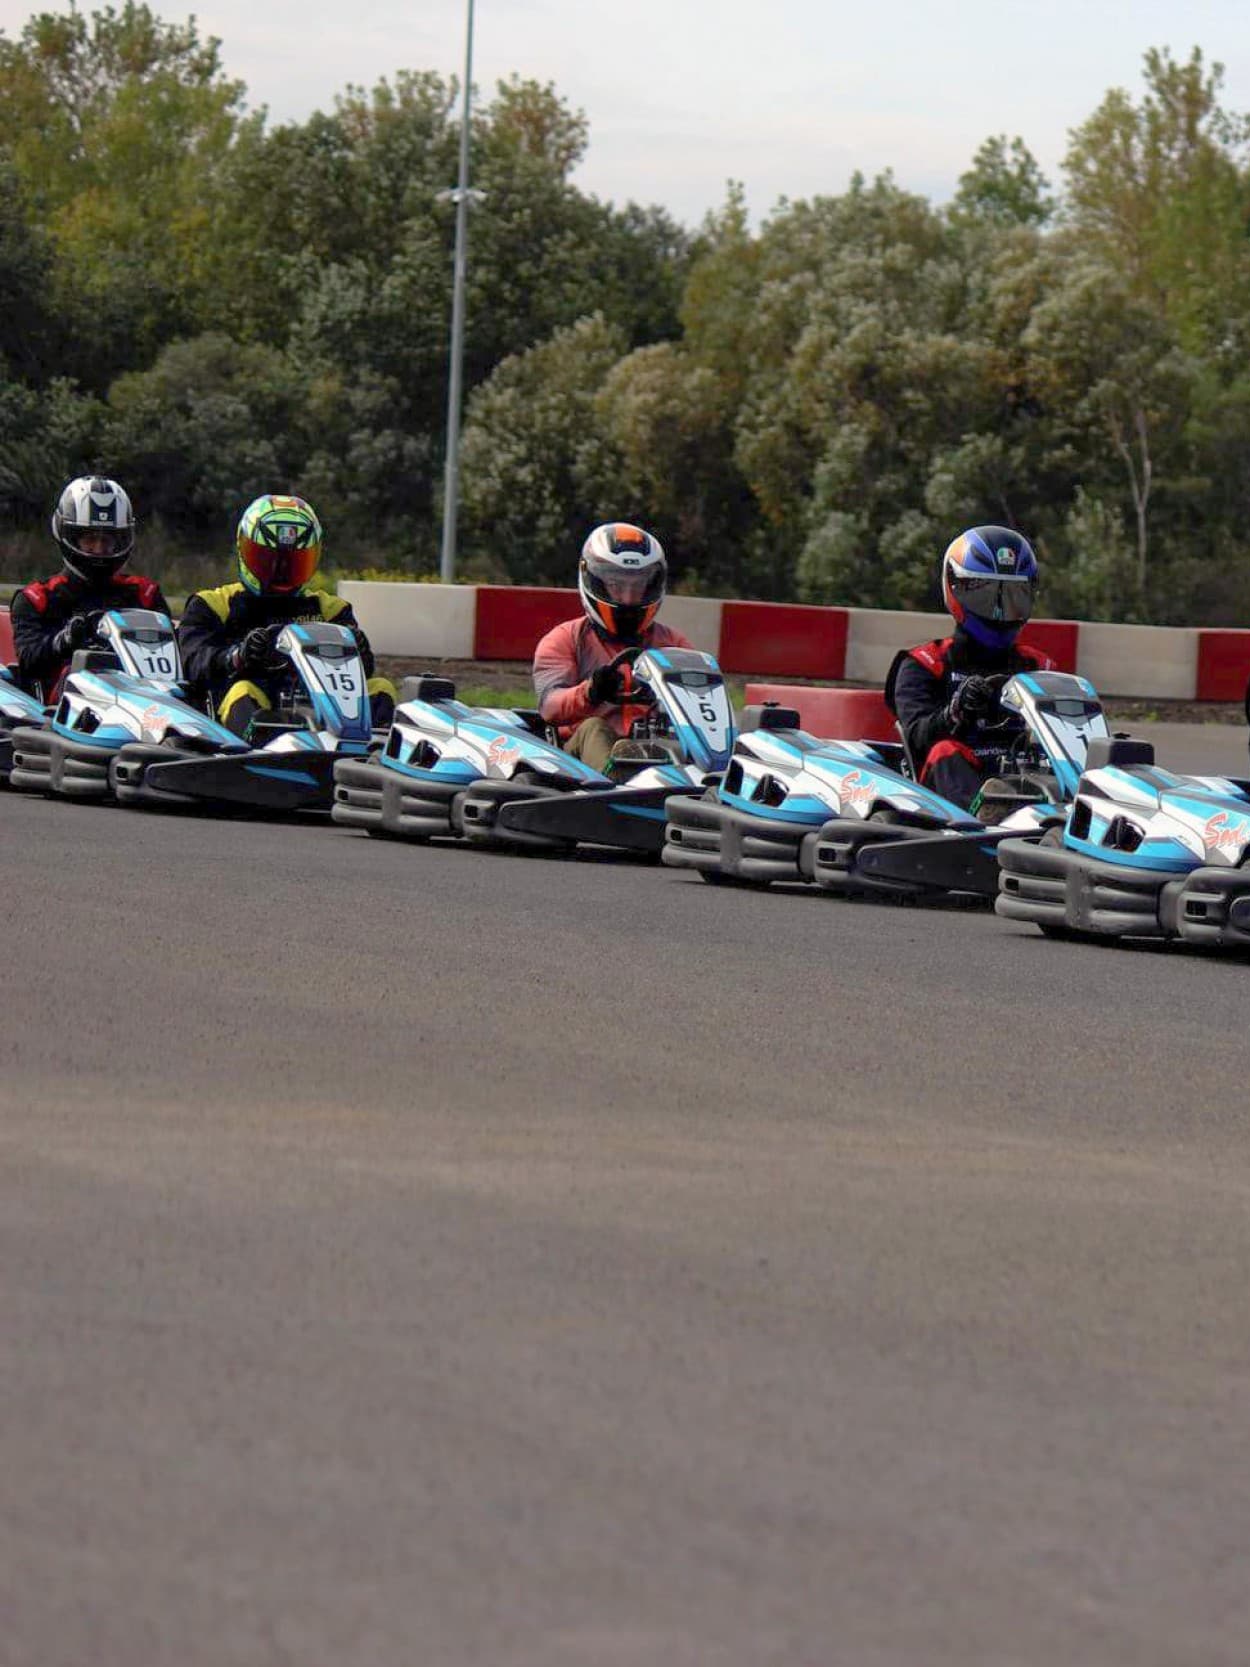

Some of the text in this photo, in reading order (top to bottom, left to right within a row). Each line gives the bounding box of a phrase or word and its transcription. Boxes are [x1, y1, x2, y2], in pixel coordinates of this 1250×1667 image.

[144, 657, 172, 674] 10
[325, 673, 356, 692] 15
[699, 703, 717, 722] 5
